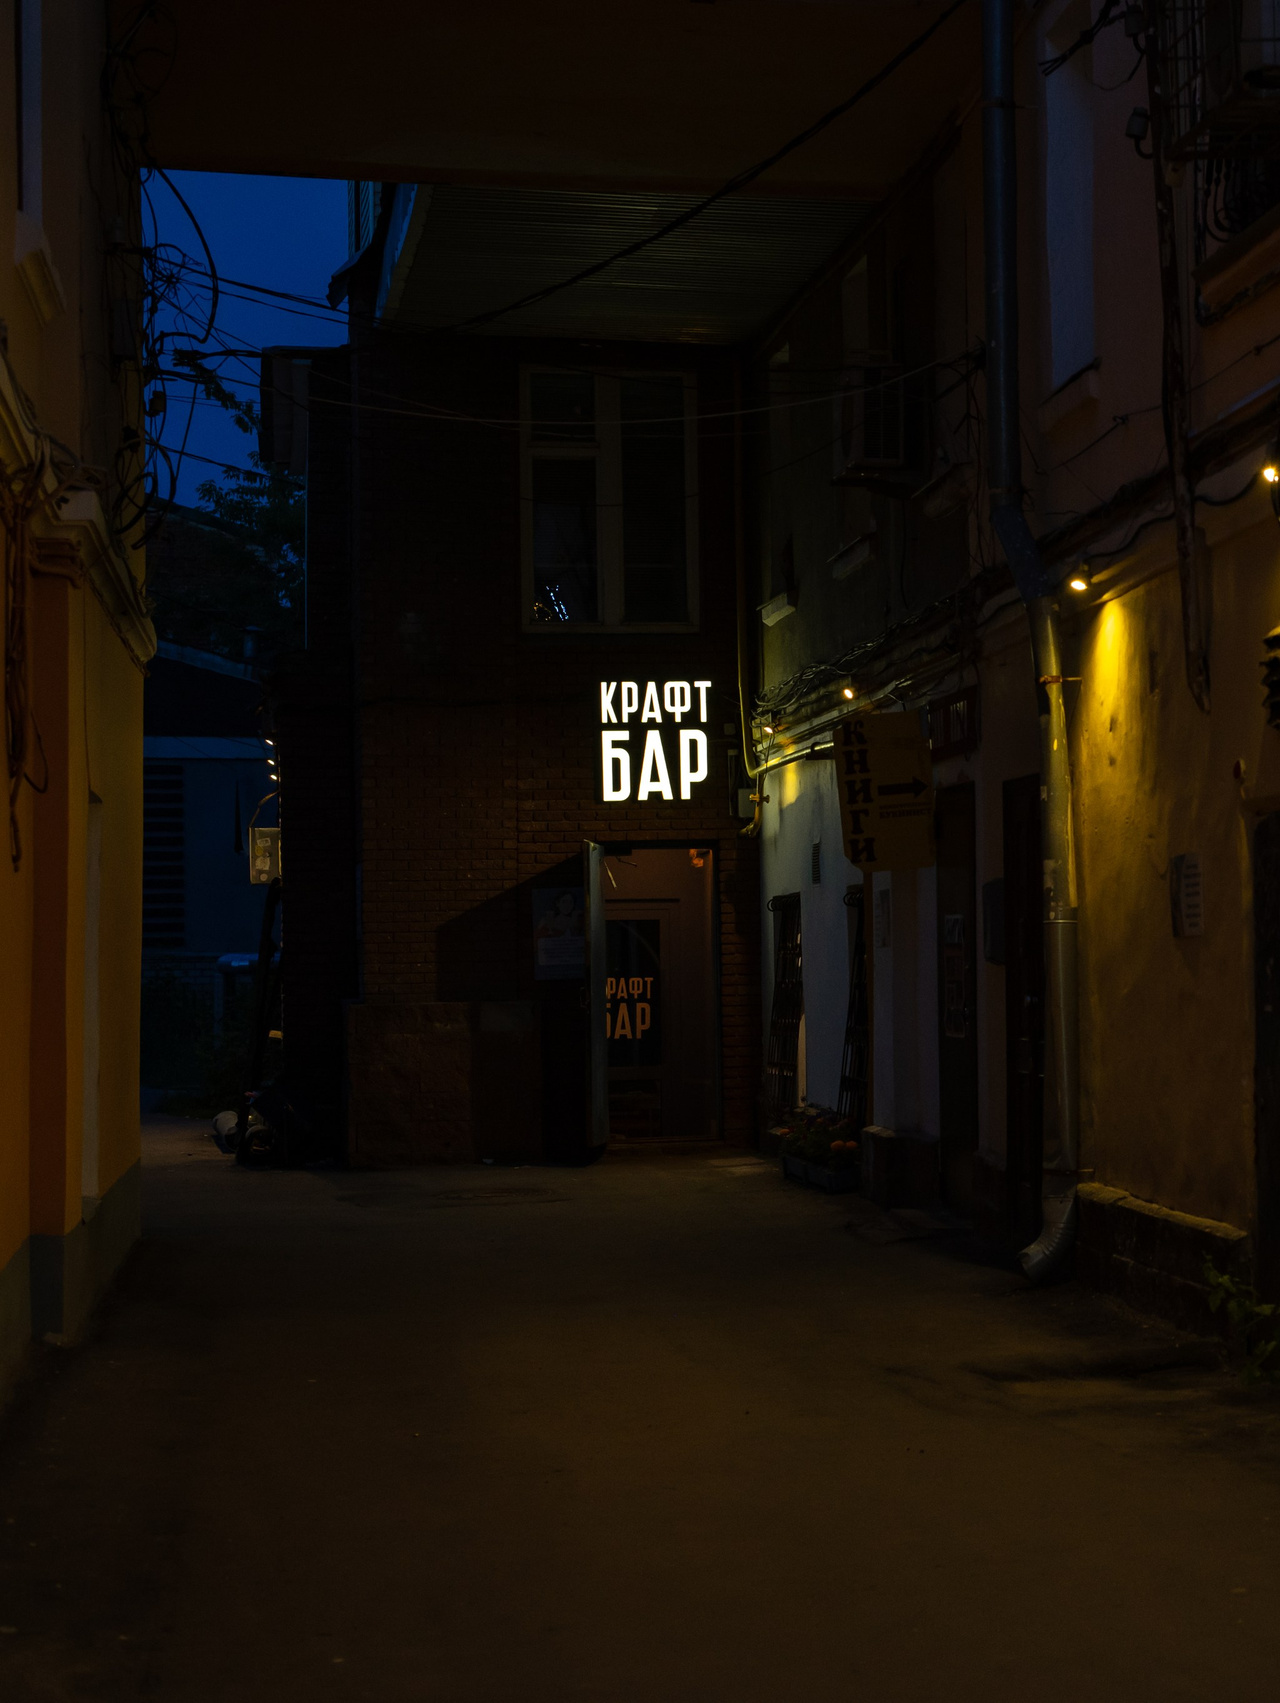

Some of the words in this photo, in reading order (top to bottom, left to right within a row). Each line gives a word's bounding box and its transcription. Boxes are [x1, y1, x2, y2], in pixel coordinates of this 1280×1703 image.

[600, 680, 712, 724] КРАФТ
[601, 729, 708, 802] БАР
[841, 718, 878, 865] КНИГИ
[605, 977, 654, 1000] РАФТ
